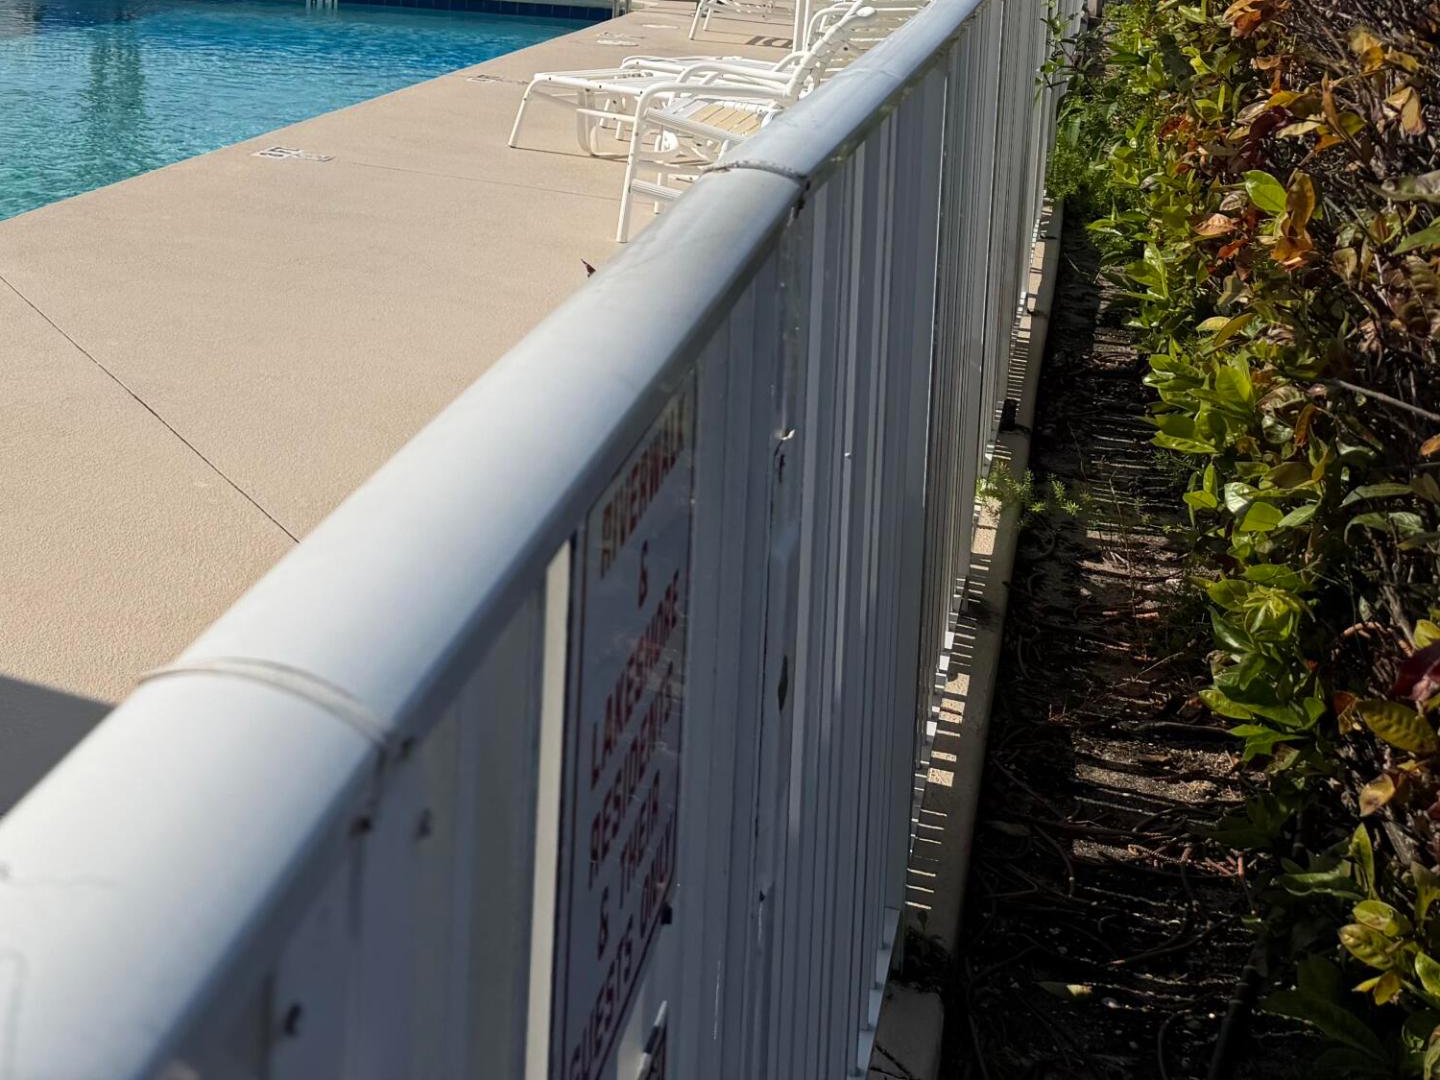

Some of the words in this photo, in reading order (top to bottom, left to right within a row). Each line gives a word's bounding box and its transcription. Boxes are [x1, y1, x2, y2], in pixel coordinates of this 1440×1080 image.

[600, 392, 686, 580] RIVERWALK
[639, 539, 648, 608] &
[591, 568, 679, 790] LAKESHORE
[588, 661, 673, 891] RESIDENTS
[598, 886, 609, 961] &
[620, 769, 659, 909] THEIR
[640, 813, 673, 939] ONLY
